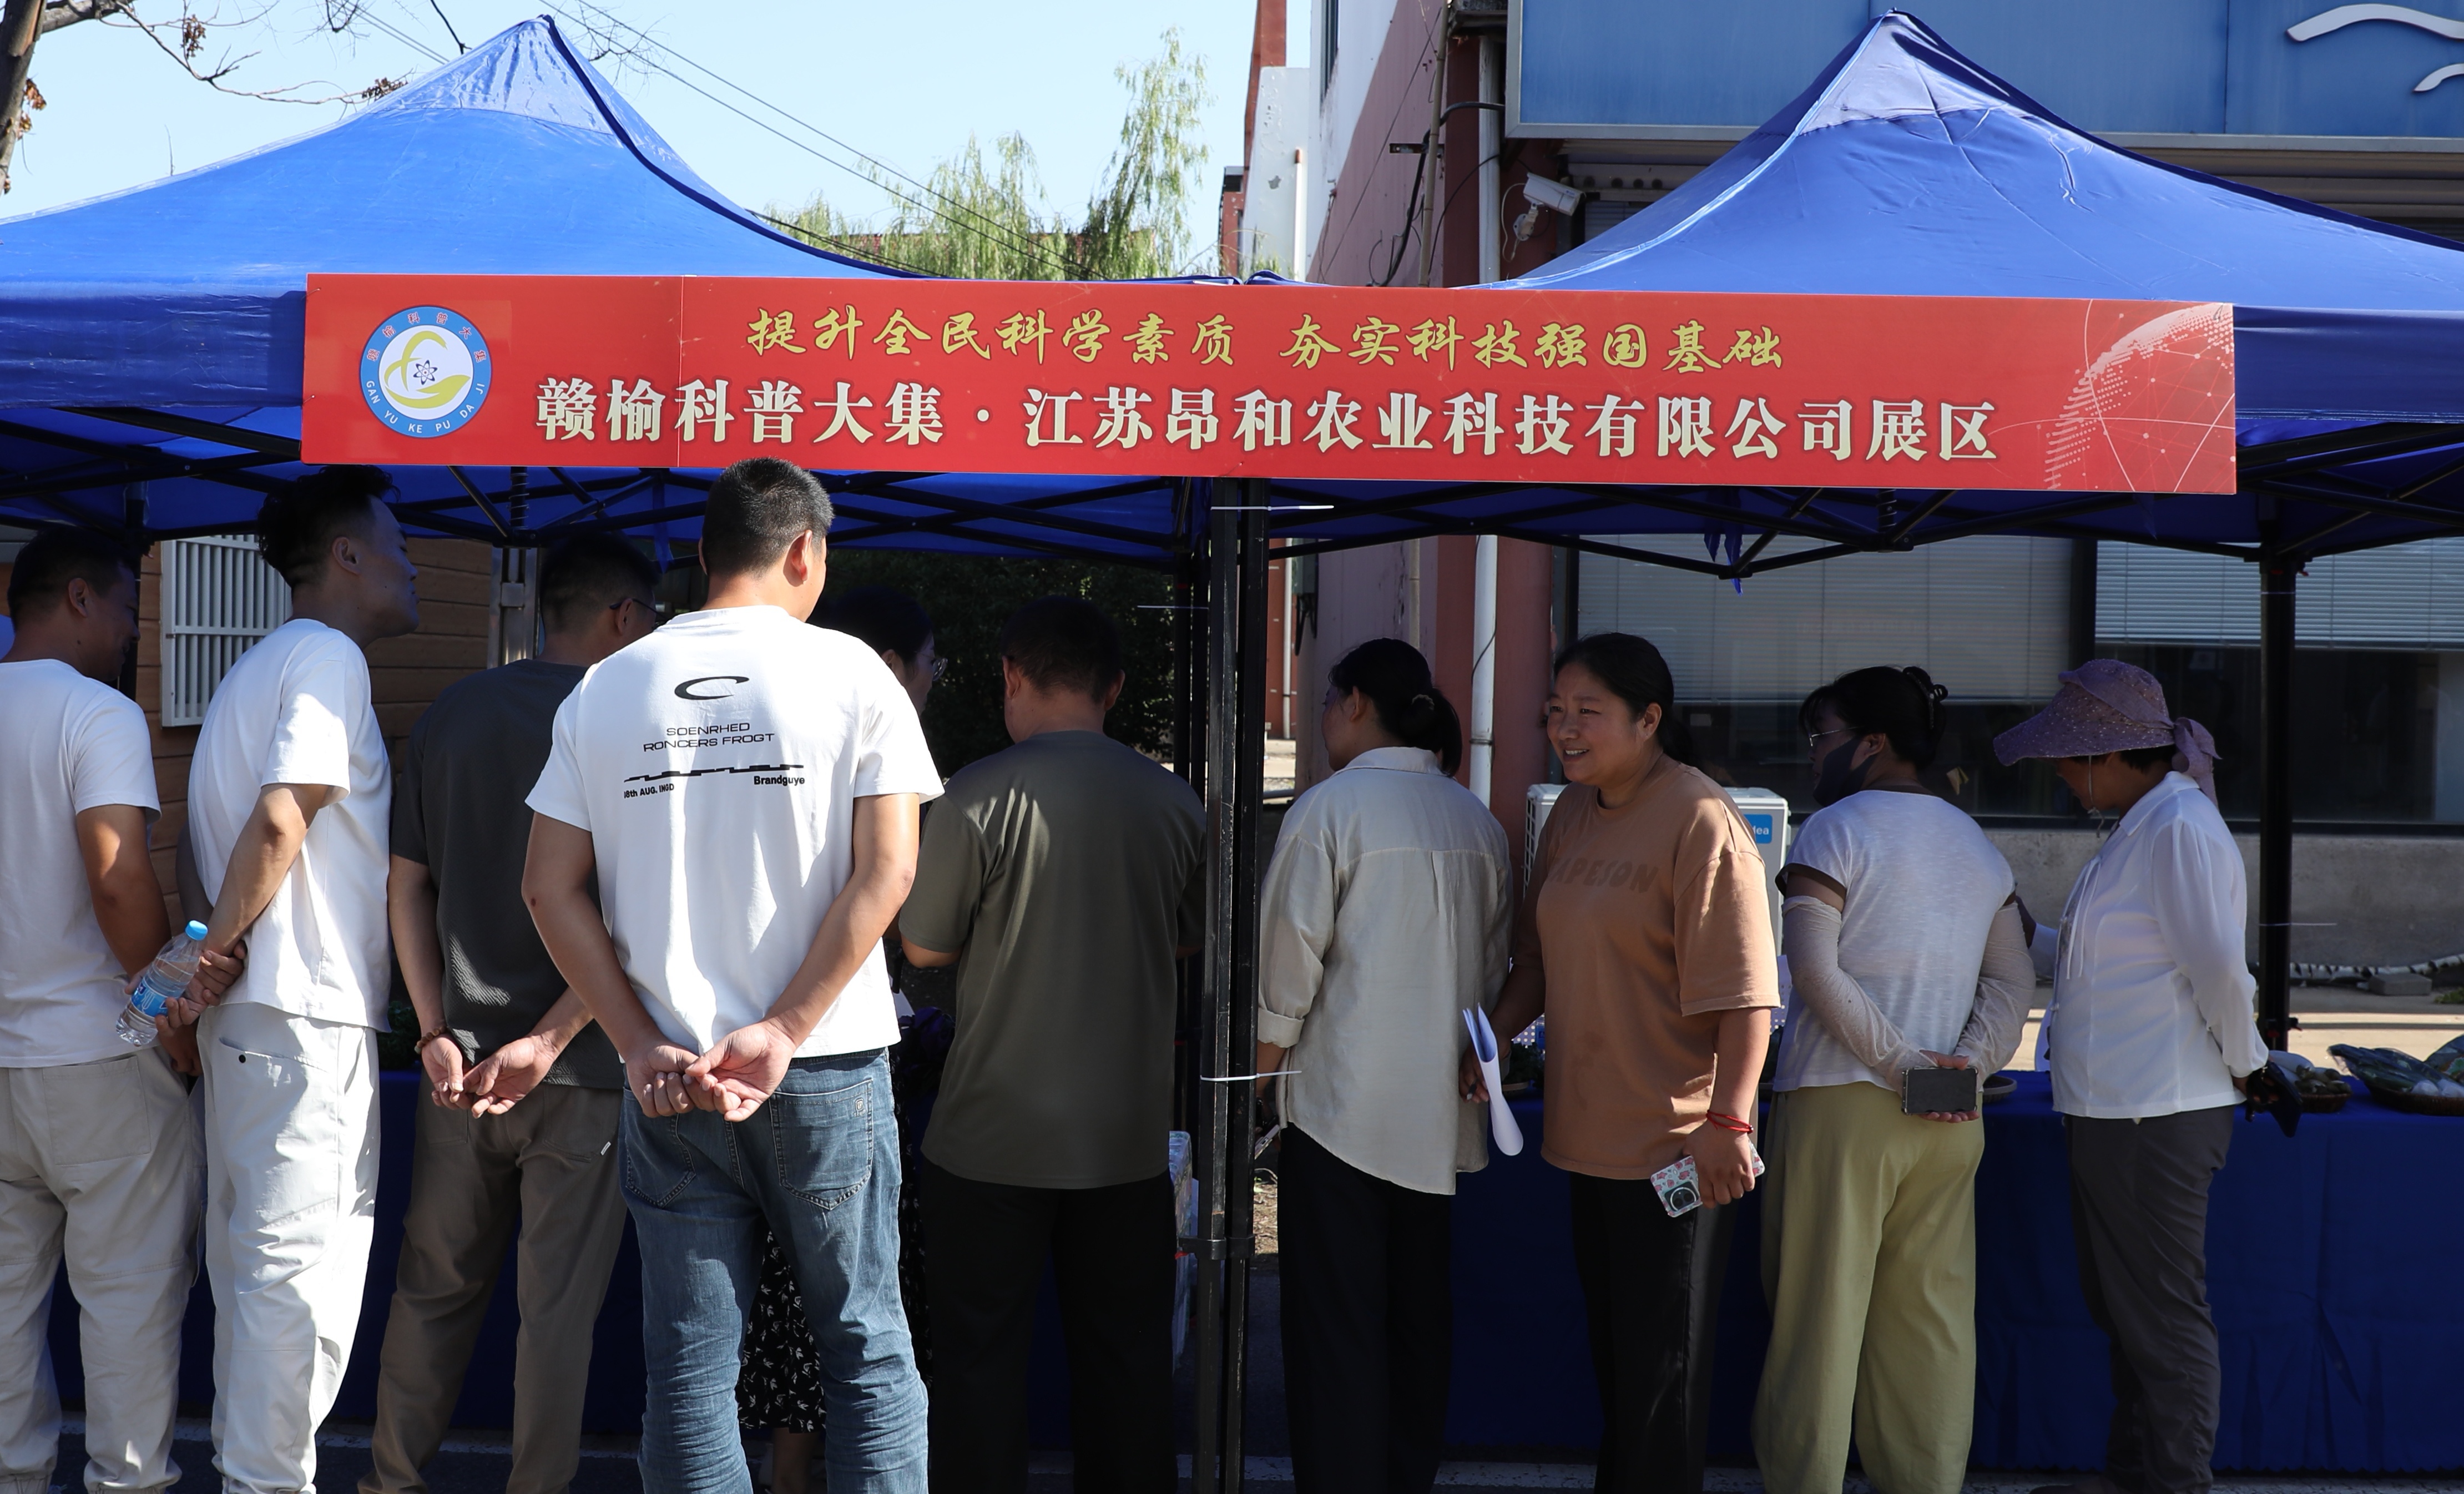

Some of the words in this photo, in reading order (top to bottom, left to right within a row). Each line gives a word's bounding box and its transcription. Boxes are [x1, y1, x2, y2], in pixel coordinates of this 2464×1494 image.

[746, 304, 1236, 366] 提升全民科学素质
[1279, 314, 1784, 374] 夯实科技强国基础
[366, 380, 381, 404] GAN
[384, 410, 398, 424] YU
[408, 423, 423, 433] KE
[435, 420, 451, 432] PU
[460, 403, 474, 418] DA
[476, 383, 485, 395] JI
[666, 723, 750, 736] SOENRHED
[643, 738, 718, 752] RONCERS
[722, 733, 775, 745] FROGT
[754, 775, 805, 786] Brandguye
